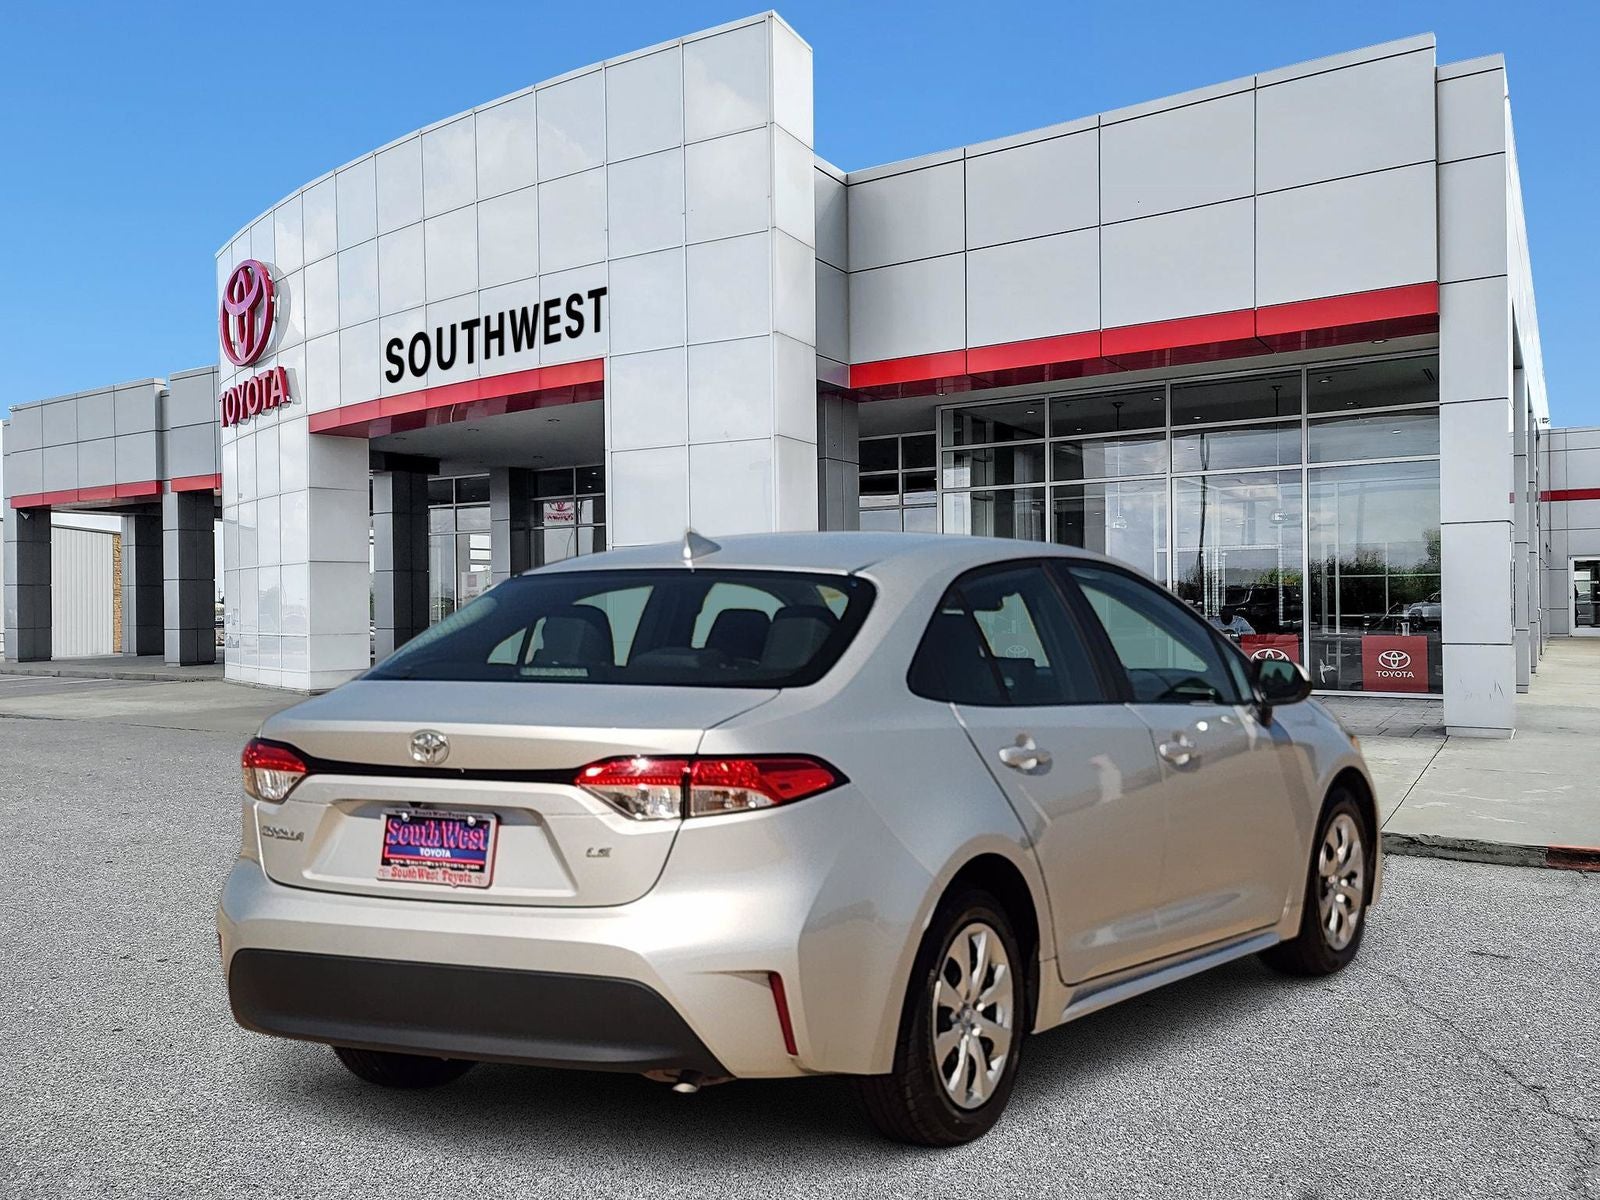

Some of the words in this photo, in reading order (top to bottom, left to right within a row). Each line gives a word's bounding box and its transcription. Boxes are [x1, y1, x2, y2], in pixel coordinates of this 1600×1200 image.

[385, 286, 608, 384] SOUTHWEST
[218, 366, 292, 428] TOYOTA
[1376, 670, 1415, 679] TOYOTA
[419, 847, 452, 858] TOYOTA
[442, 869, 473, 886] Toyota
